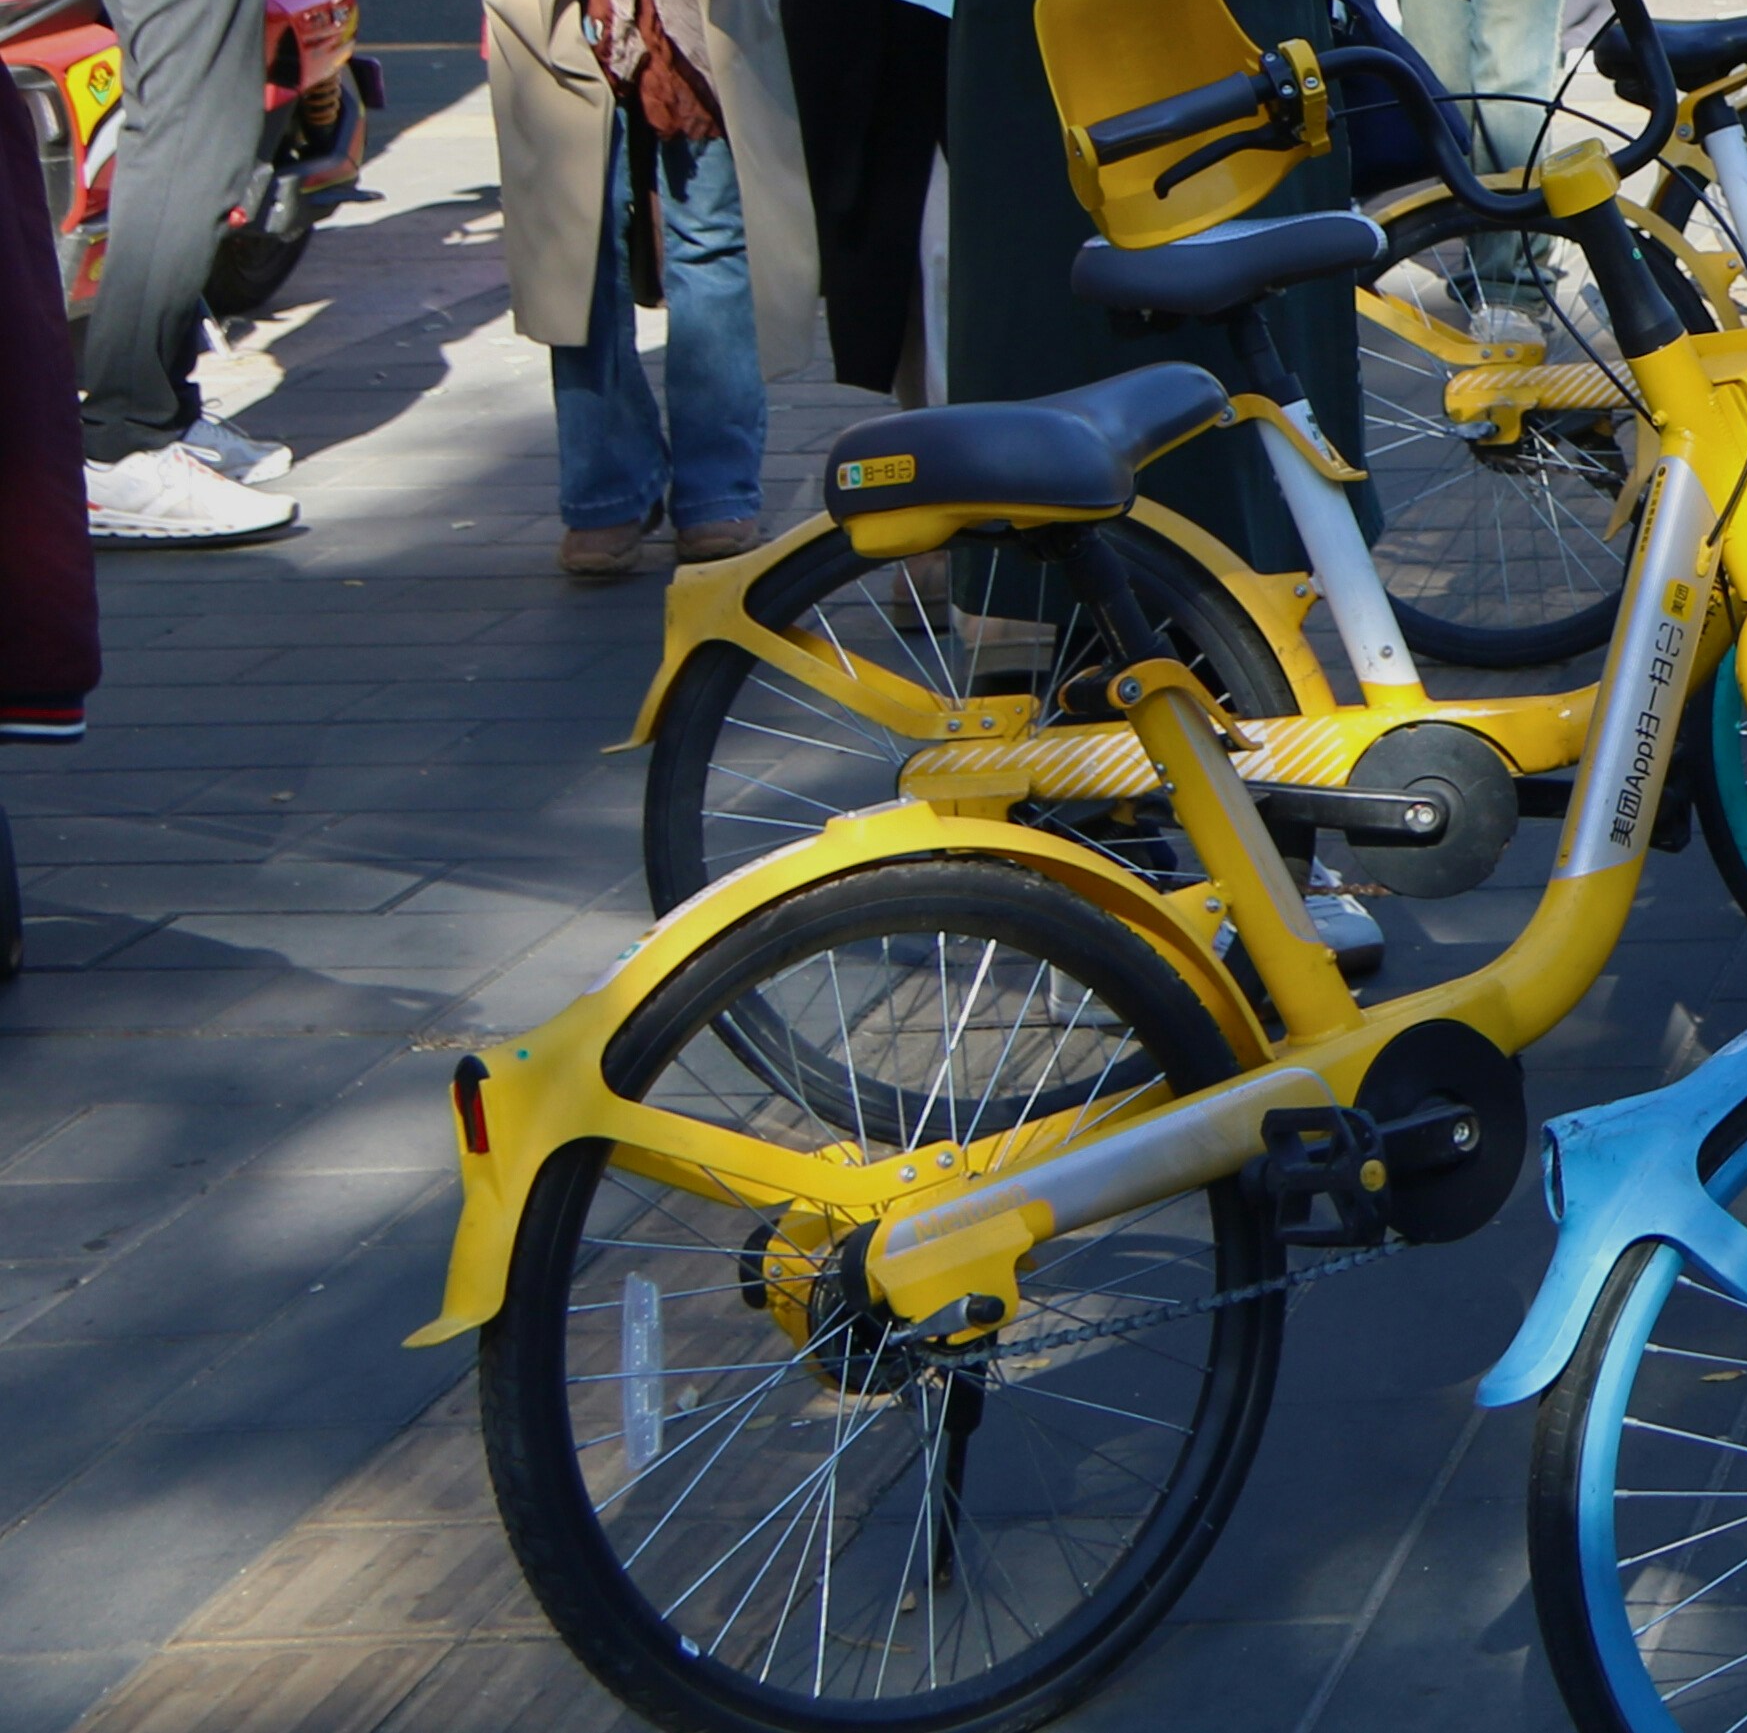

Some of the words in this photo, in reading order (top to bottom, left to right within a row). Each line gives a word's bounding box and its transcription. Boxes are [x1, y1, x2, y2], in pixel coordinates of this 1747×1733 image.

[1671, 584, 1690, 617] 美团
[1609, 656, 1674, 848] 美团App扫一扫
[909, 1182, 1029, 1245] Meituan
